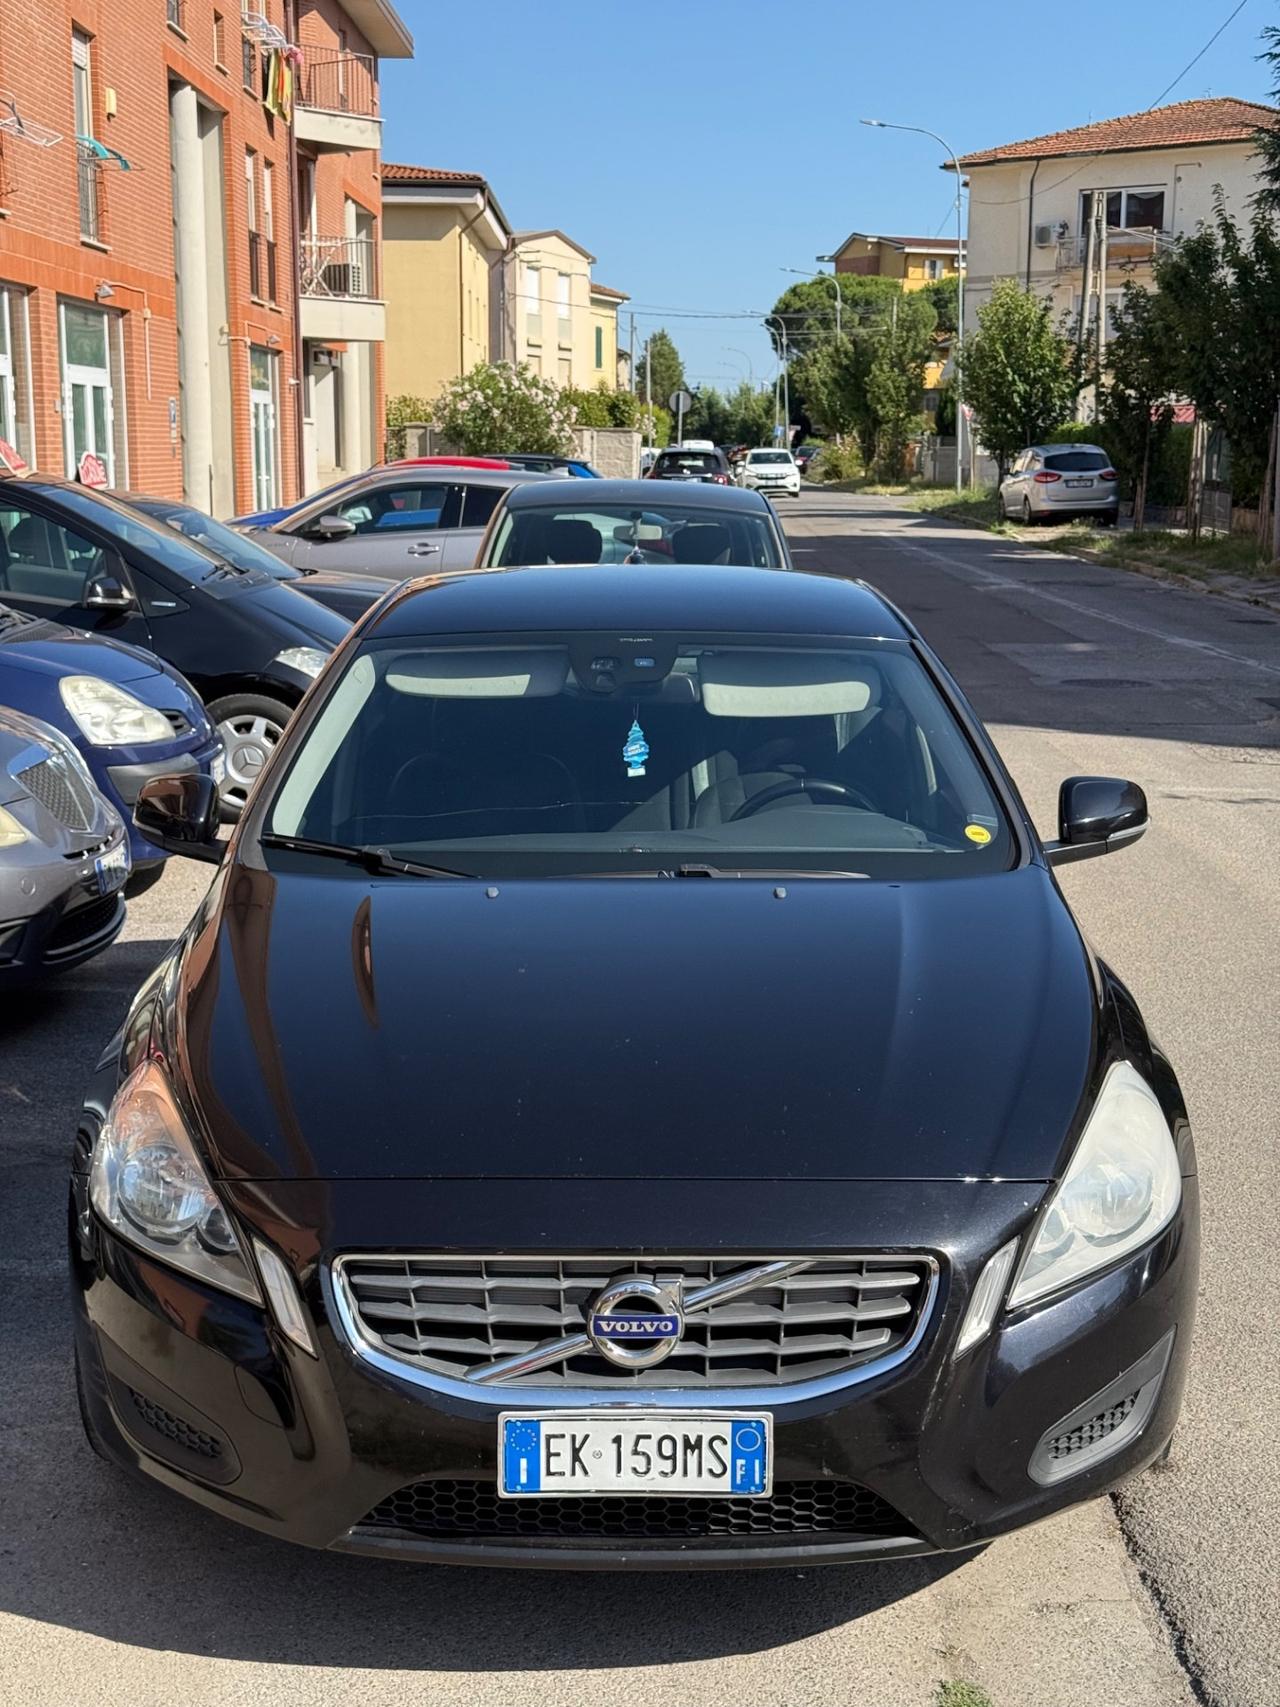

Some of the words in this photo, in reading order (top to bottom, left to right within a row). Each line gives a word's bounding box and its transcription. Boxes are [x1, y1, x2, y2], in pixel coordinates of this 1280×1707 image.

[597, 1320, 674, 1333] VOLVO
[545, 1433, 591, 1477] EK
[611, 1433, 728, 1478] 159MS
